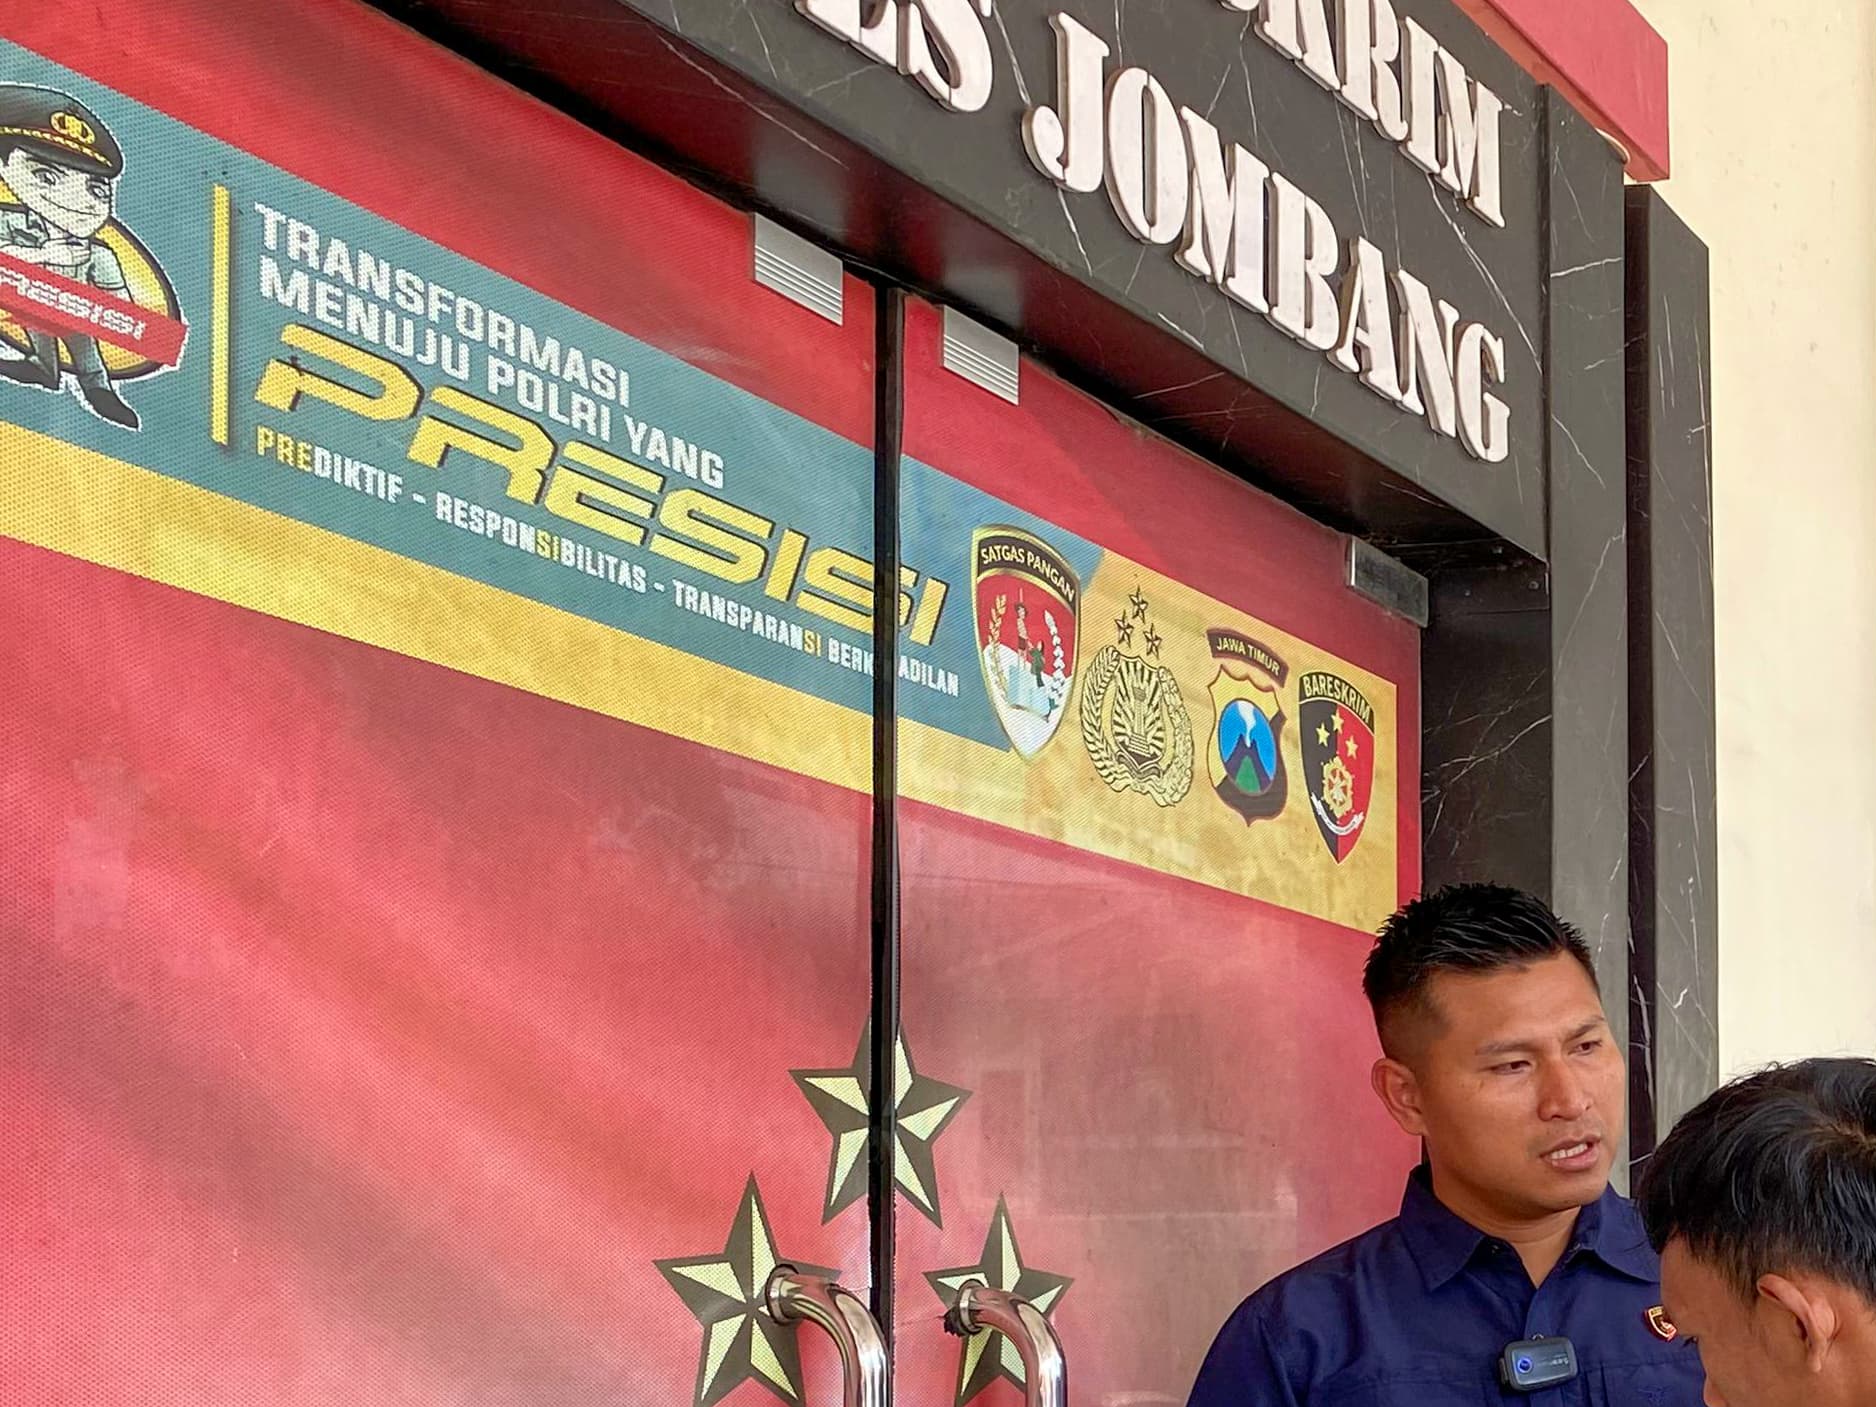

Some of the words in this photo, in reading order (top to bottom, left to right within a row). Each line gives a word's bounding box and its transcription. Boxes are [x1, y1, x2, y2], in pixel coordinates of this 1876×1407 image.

[255, 203, 630, 407] TRANSFORMASI
[1022, 12, 1511, 463] JOMBANG
[259, 256, 471, 382] MENUJU
[487, 354, 611, 443] POLRI
[623, 414, 726, 490] YANG
[255, 323, 949, 646] PRESISI
[256, 425, 403, 503] PREDIKTIF
[436, 492, 647, 594] RESPONSIBILITAS
[672, 579, 823, 658] TRANSPARANSI
[828, 637, 960, 698] BERKADILAN
[981, 544, 1025, 564] SATGAS
[1026, 550, 1075, 602] PANGAN
[1216, 637, 1246, 655] JAWA
[1247, 644, 1281, 676] TIMUR
[1303, 675, 1372, 722] BARESKRIM
